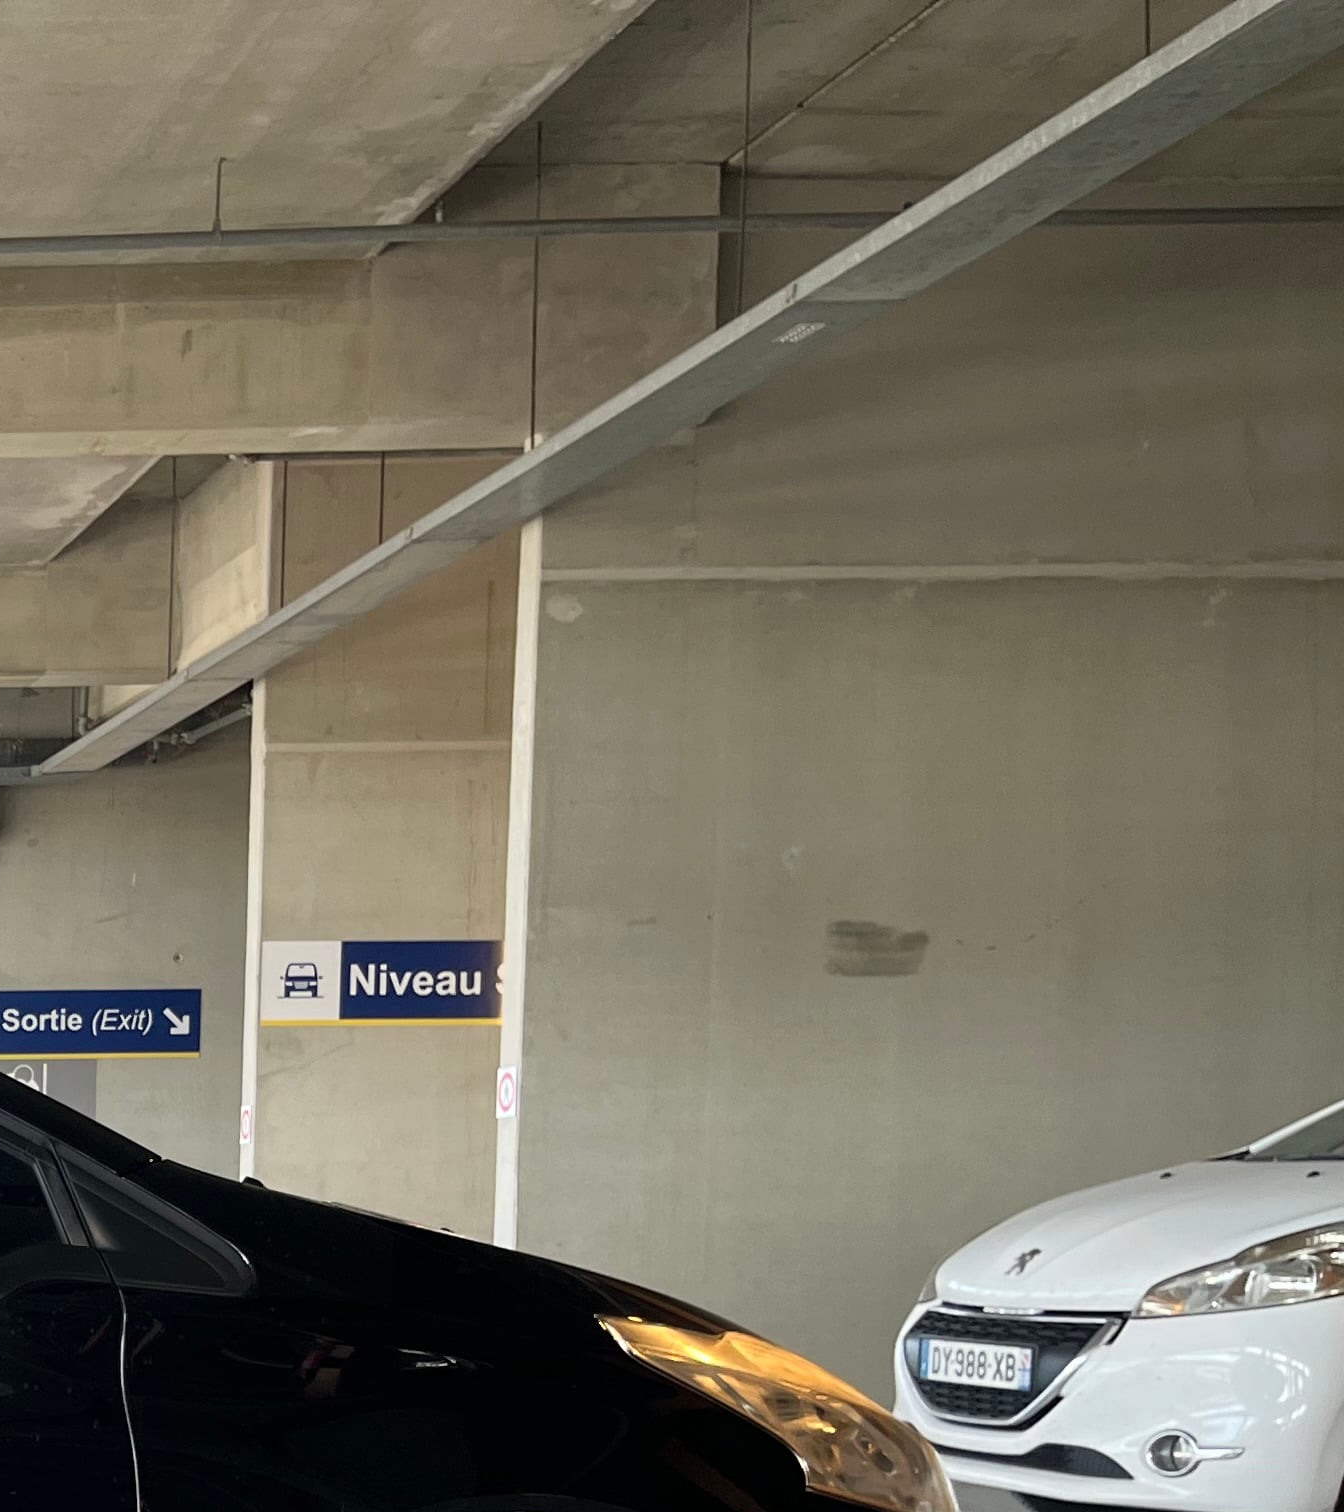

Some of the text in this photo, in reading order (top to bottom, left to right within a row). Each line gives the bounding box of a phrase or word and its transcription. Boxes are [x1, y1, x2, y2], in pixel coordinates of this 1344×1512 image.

[349, 963, 482, 996] Niveau
[2, 1008, 153, 1036] Sortie (Exit)
